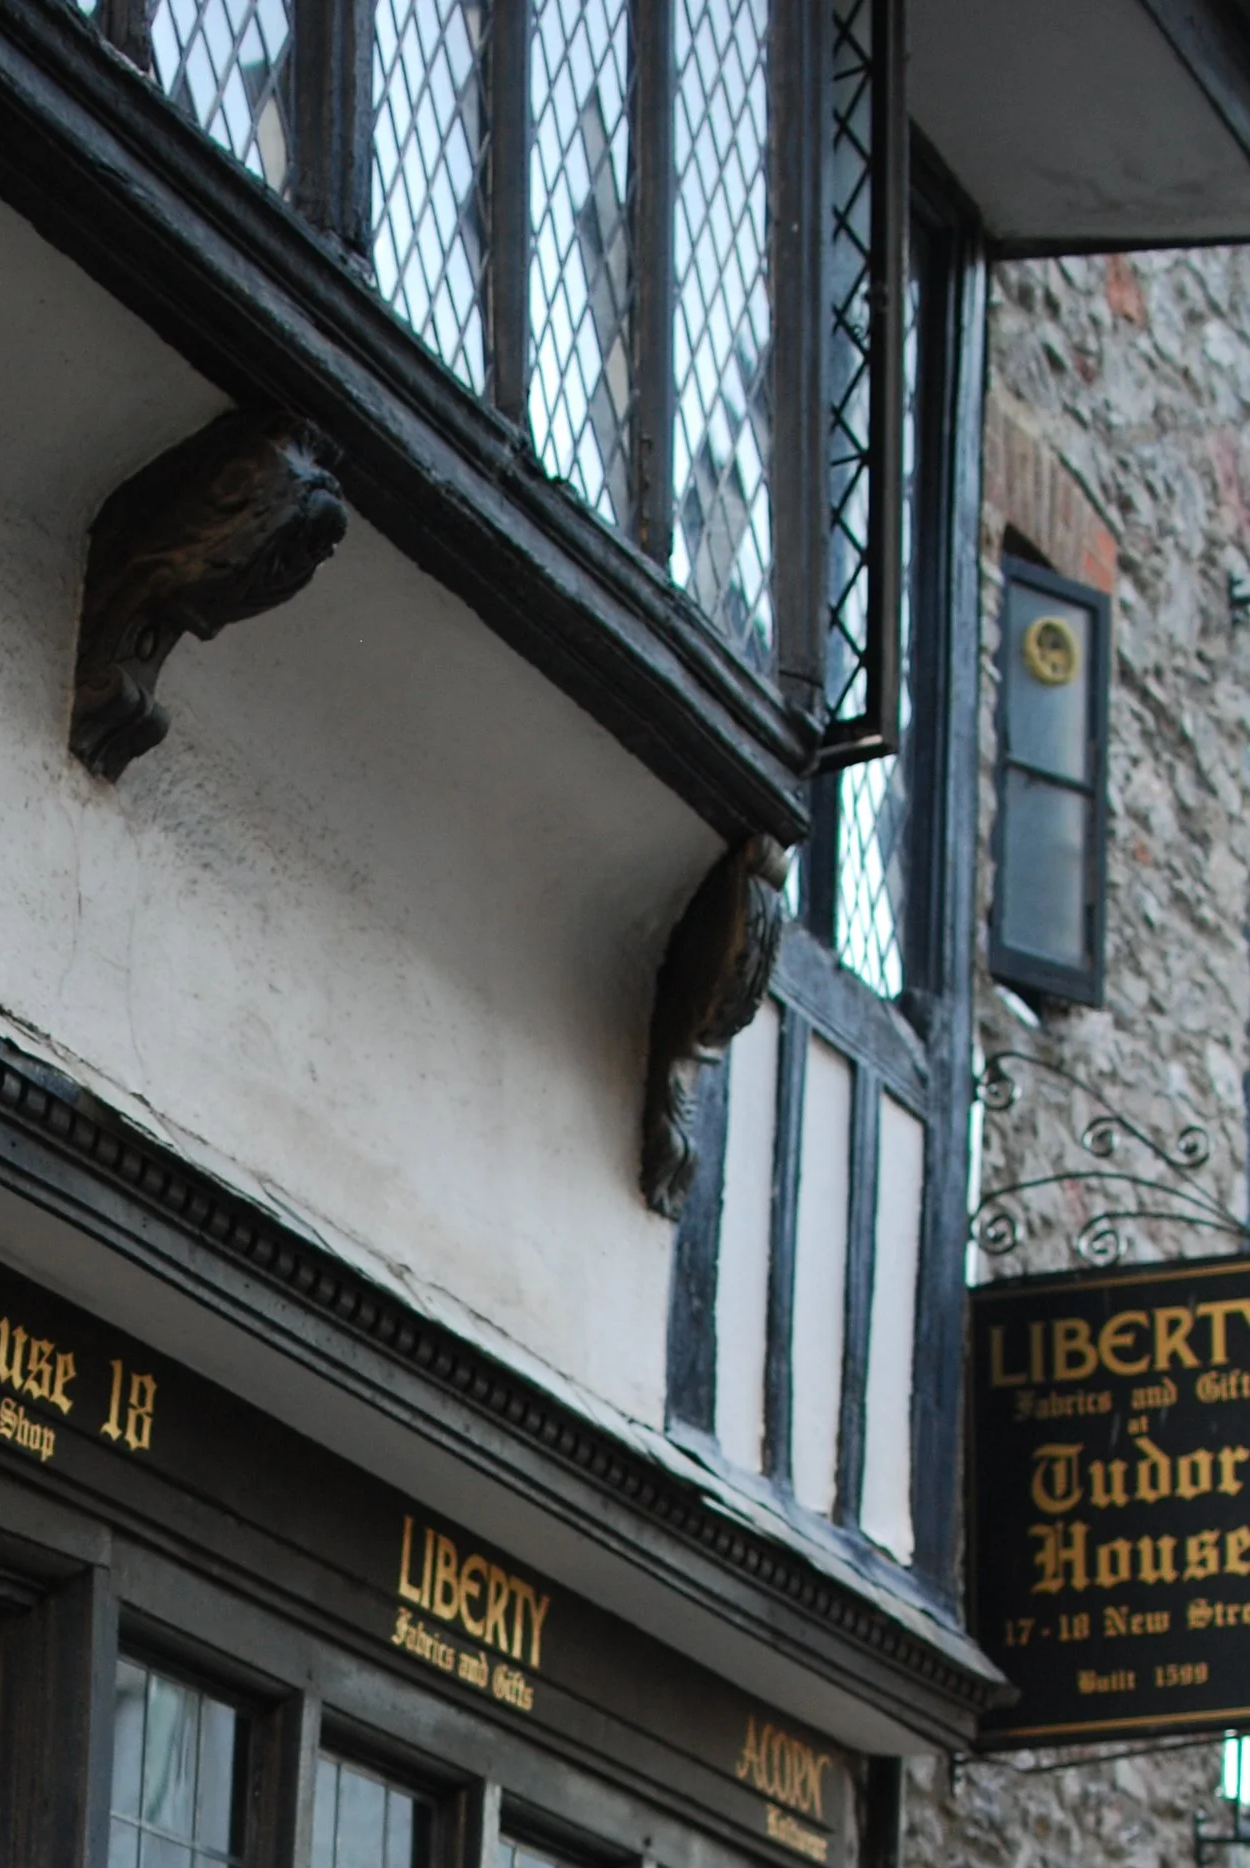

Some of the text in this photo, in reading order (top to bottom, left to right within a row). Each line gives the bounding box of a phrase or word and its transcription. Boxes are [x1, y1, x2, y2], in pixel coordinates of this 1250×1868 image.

[990, 1300, 1250, 1388] LIBERT
[100, 1358, 158, 1452] 18
[1131, 1375, 1178, 1410] and
[1031, 1437, 1250, 1515] Tudor
[397, 1513, 551, 1669] LIBERTY
[1028, 1520, 1250, 1595] House
[391, 1607, 535, 1712] Fabrics and Gifts
[1103, 1605, 1171, 1638] New
